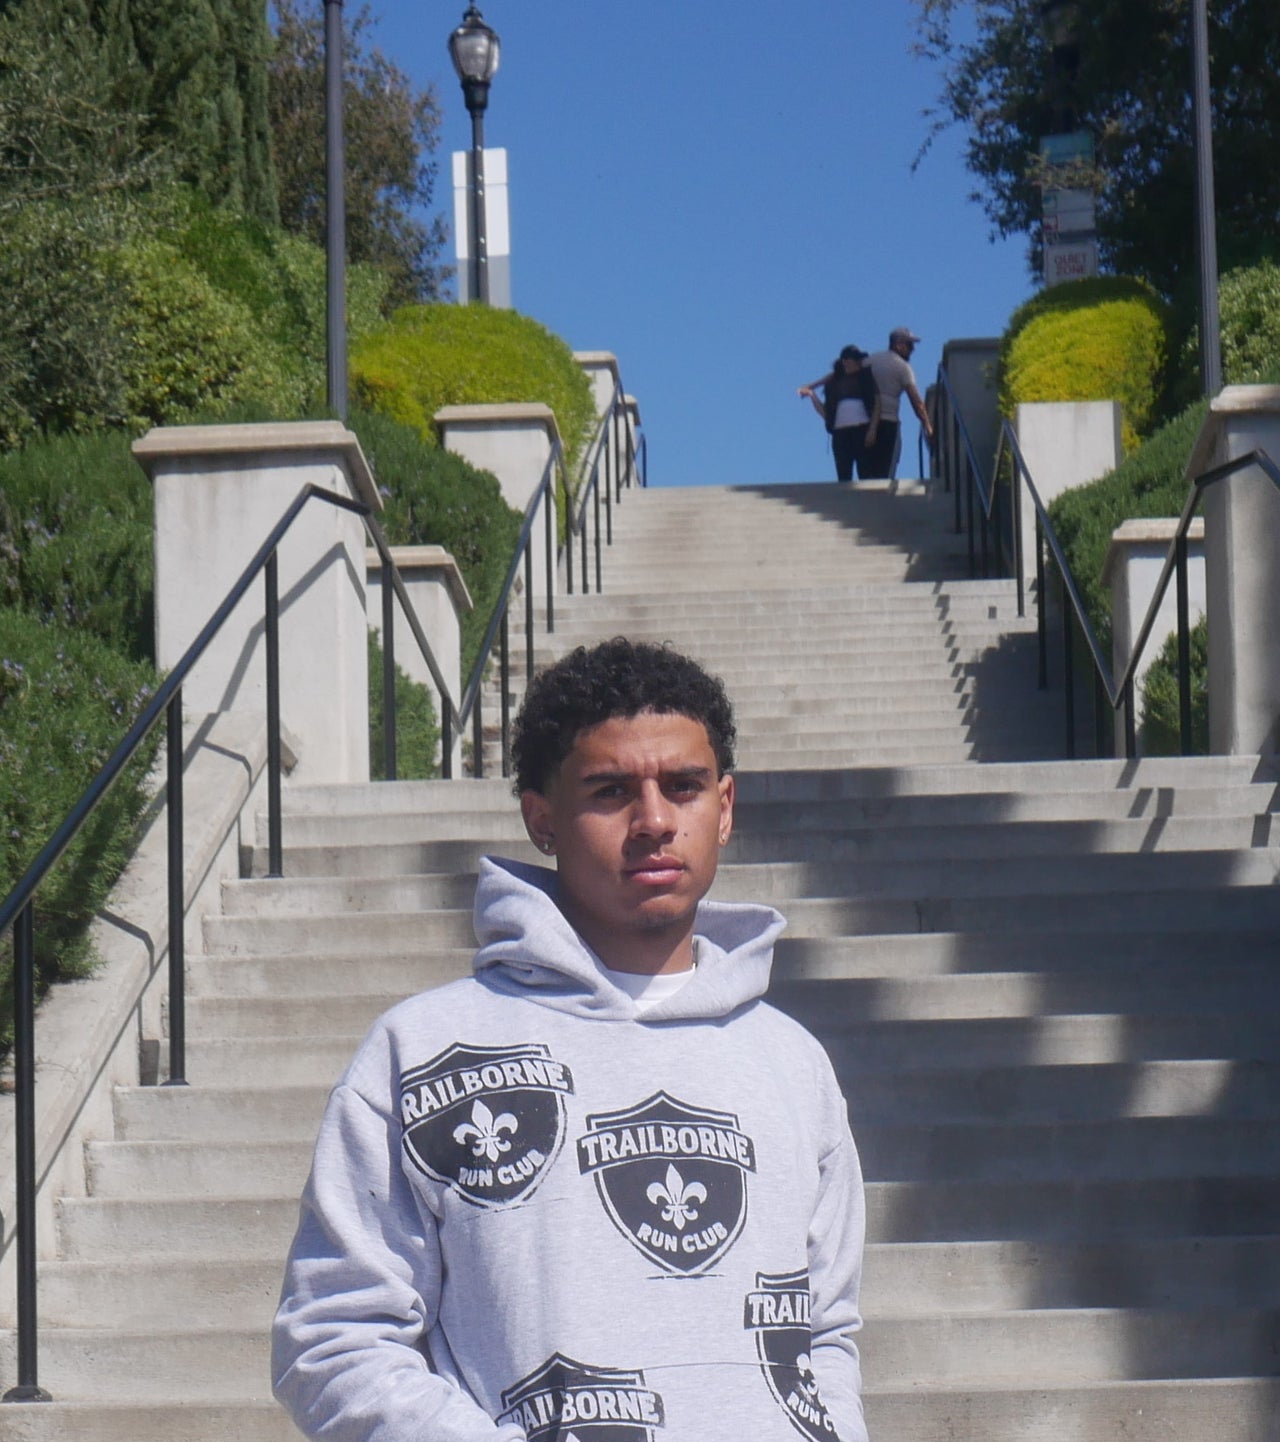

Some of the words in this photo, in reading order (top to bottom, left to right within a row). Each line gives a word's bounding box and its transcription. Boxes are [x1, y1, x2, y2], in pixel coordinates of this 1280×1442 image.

[1054, 252, 1087, 265] QUIET
[1056, 264, 1085, 275] ZONE
[581, 1124, 752, 1169] TRAILBORNE
[458, 1166, 493, 1187] RUN
[497, 1149, 545, 1185] CLUB
[636, 1222, 678, 1252] RUN
[681, 1220, 728, 1254] CLUB
[786, 1391, 821, 1427] RUN
